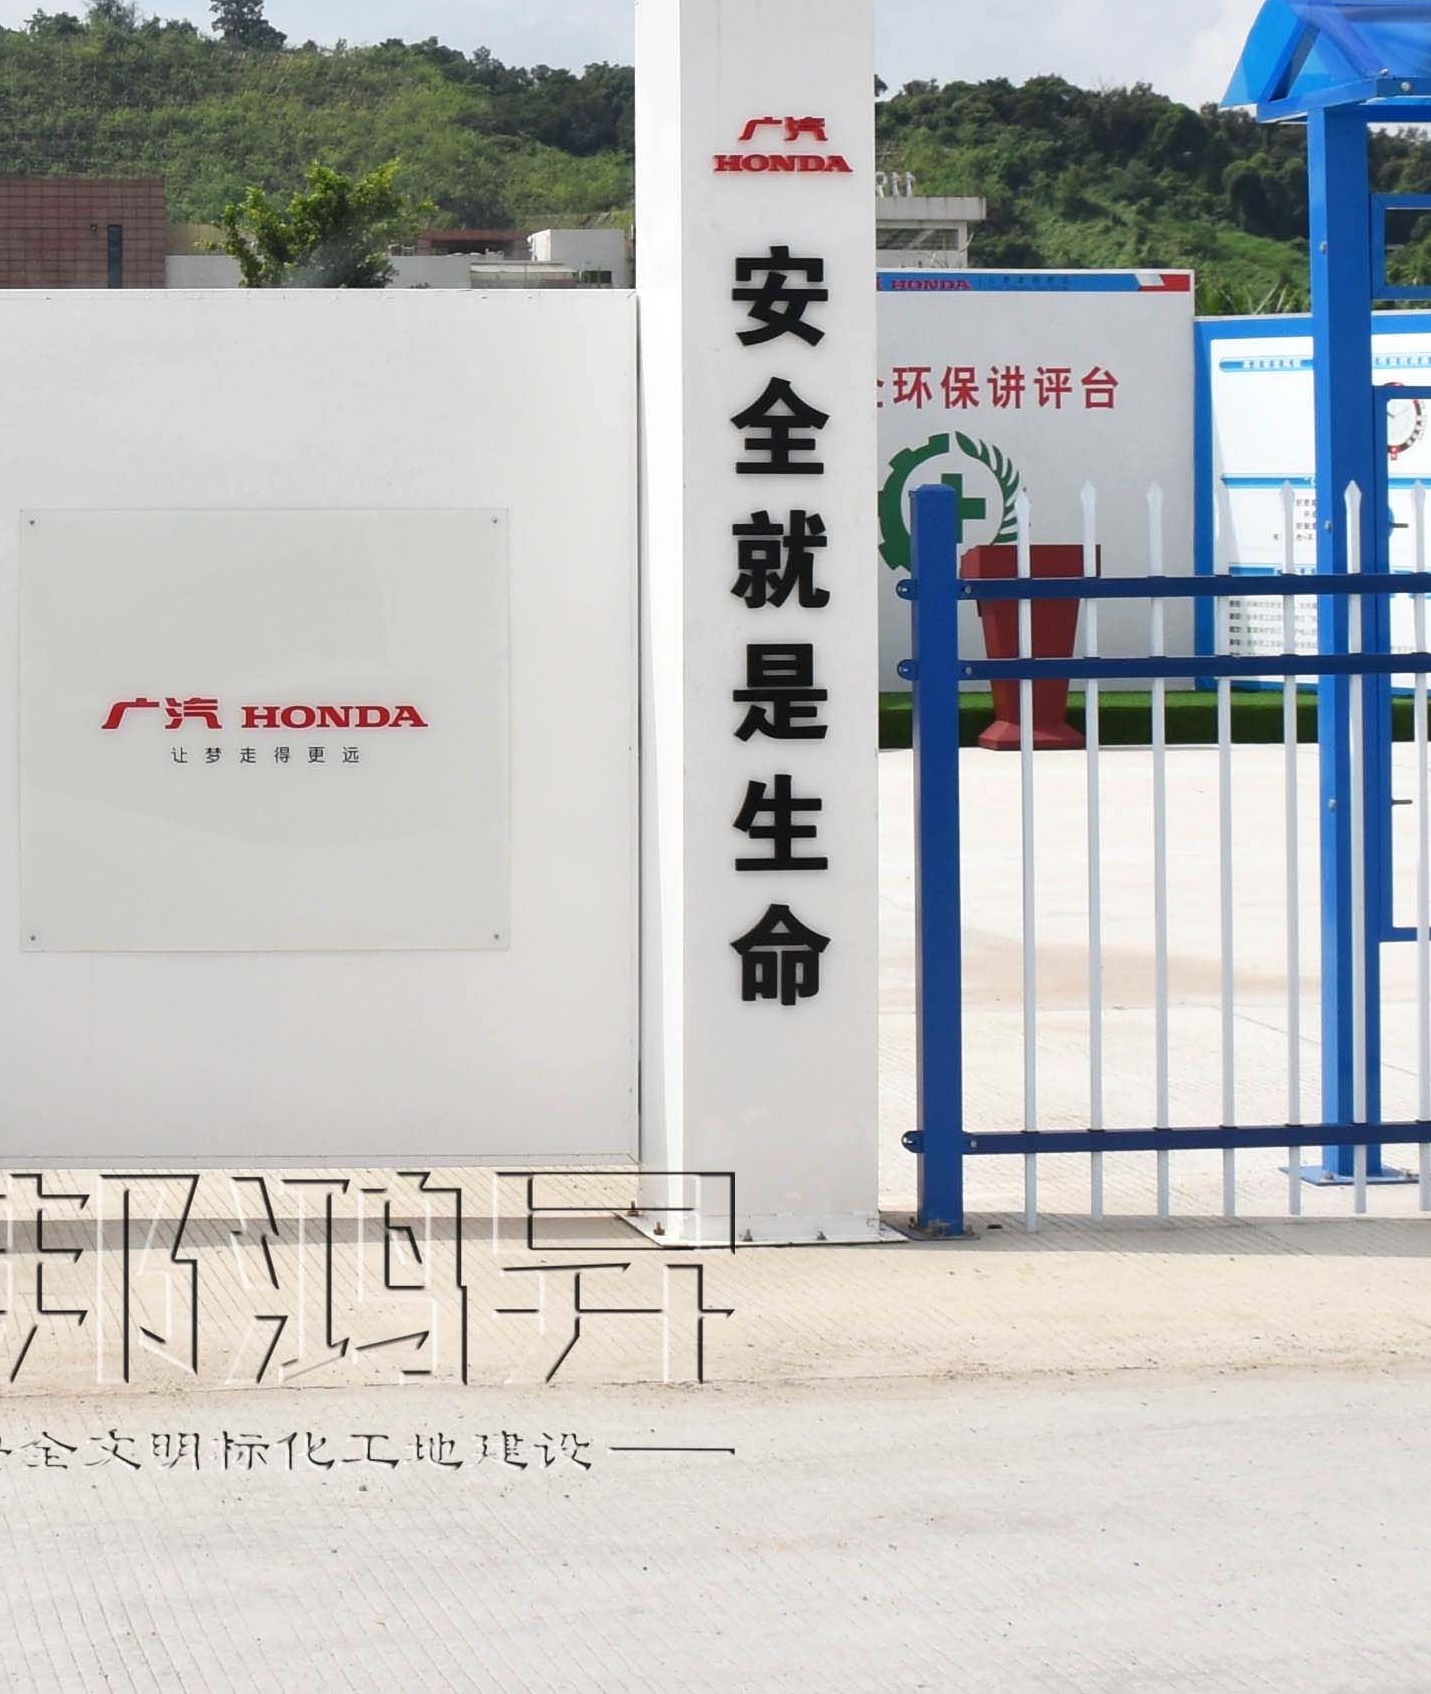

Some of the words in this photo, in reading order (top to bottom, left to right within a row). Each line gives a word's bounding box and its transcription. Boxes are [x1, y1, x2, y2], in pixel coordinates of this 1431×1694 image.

[739, 116, 828, 142] 广汽
[714, 153, 853, 173] HONDA
[877, 365, 1120, 409] 环保讲评台
[730, 245, 831, 1006] 安全就是生命
[101, 697, 222, 729] 广汽
[241, 706, 428, 728] HONDA
[171, 746, 360, 764] 让梦走得更远
